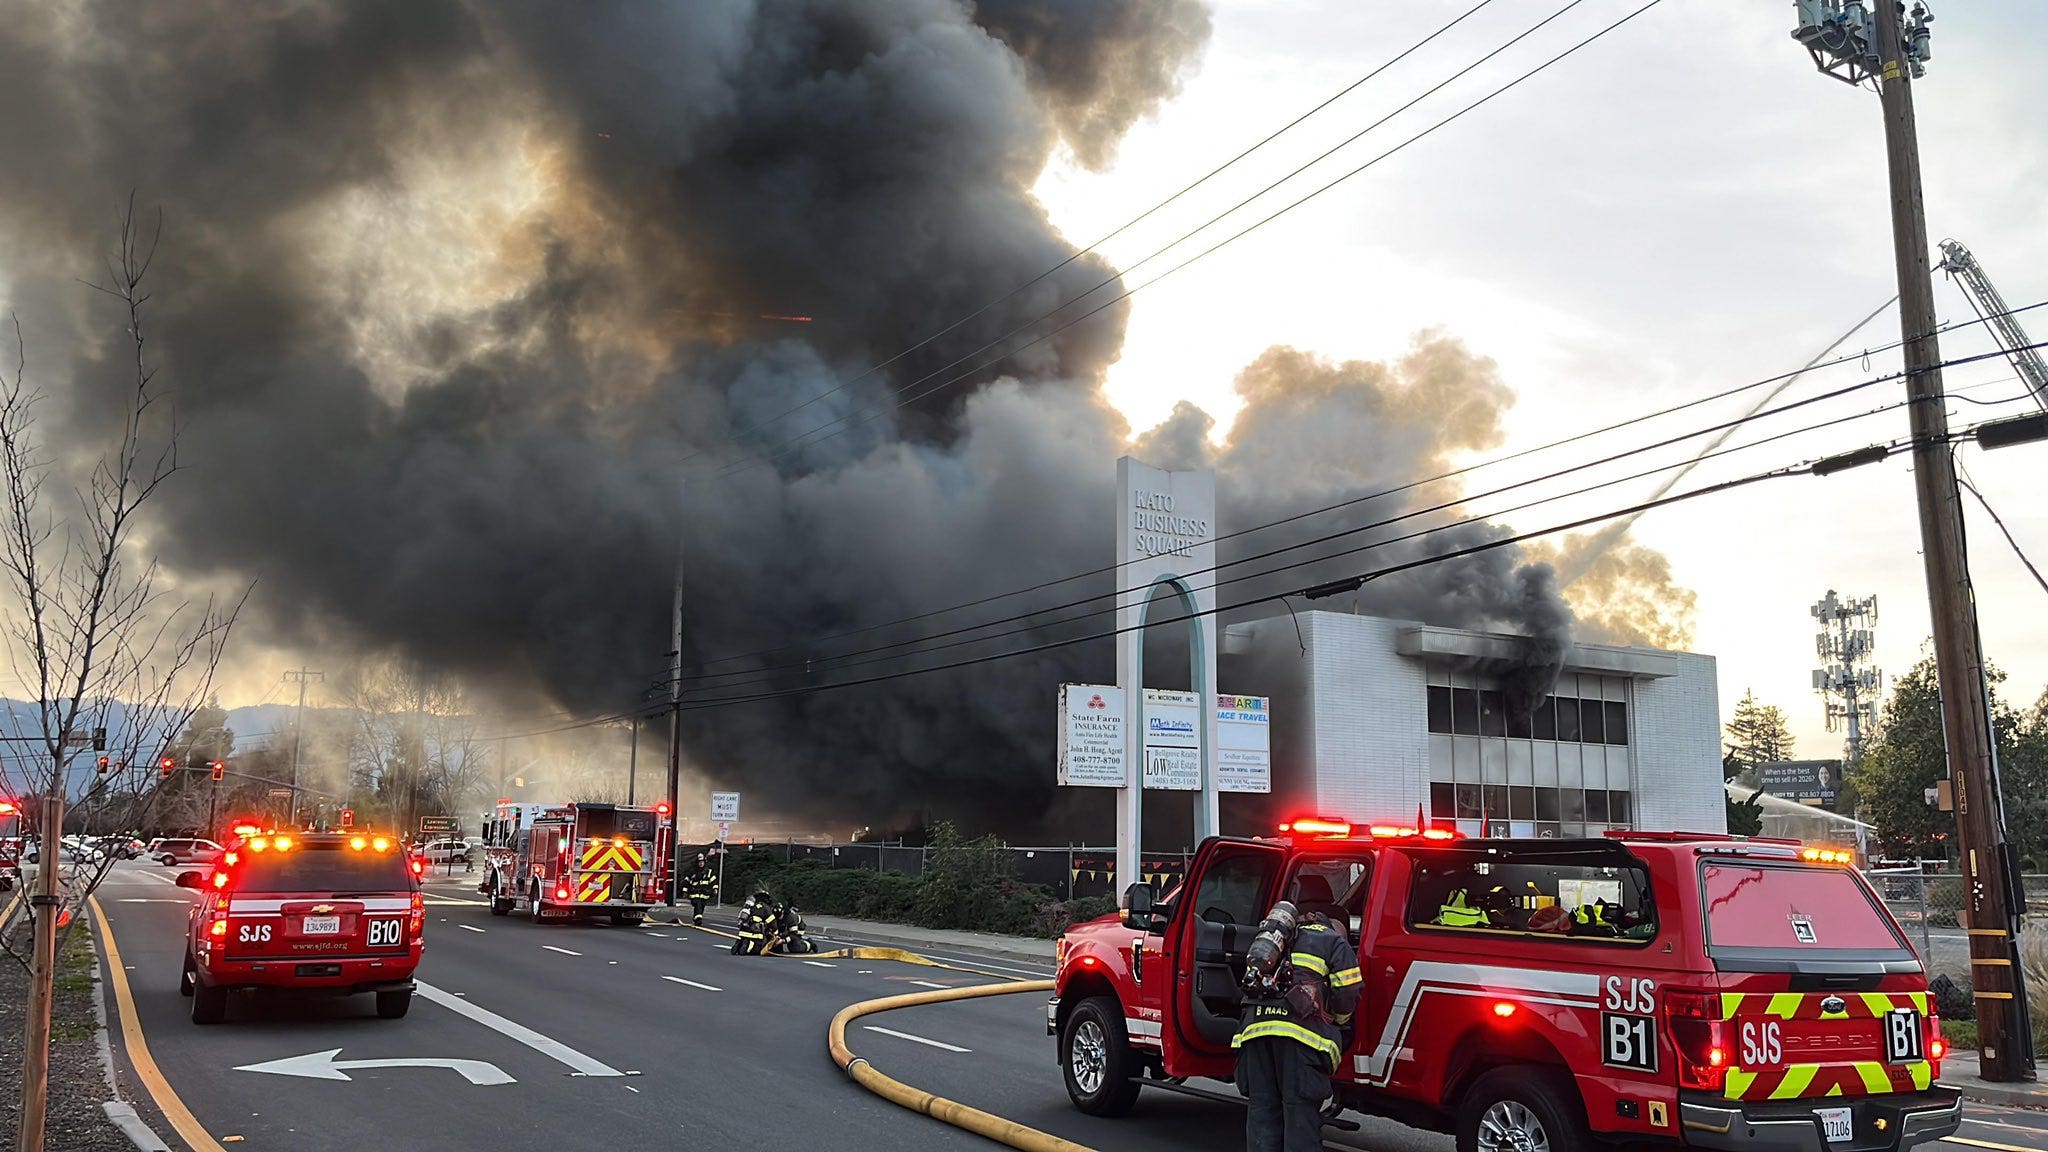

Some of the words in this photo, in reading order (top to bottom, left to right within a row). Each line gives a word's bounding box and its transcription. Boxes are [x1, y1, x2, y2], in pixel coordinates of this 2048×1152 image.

[1135, 488, 1175, 512] KATO
[1134, 511, 1207, 537] BUSINESS
[1136, 533, 1193, 557] SQUARE
[1239, 713, 1267, 721] TRAVEL
[1075, 723, 1118, 731] INSURANCE
[1108, 747, 1122, 755] Agent
[1181, 751, 1197, 759] Realty
[1073, 756, 1121, 764] 408-777-8700
[1181, 760, 1197, 770] Estate
[239, 925, 272, 942] SJS
[370, 920, 399, 944] B10
[292, 942, 348, 951] www.sjfd.org
[1606, 976, 1655, 1014] SJS
[1256, 1006, 1262, 1016] B
[1265, 1006, 1288, 1016] MAAS
[1610, 1016, 1647, 1065] B1
[1742, 1021, 1781, 1065] SJS
[1892, 1013, 1918, 1057] B1
